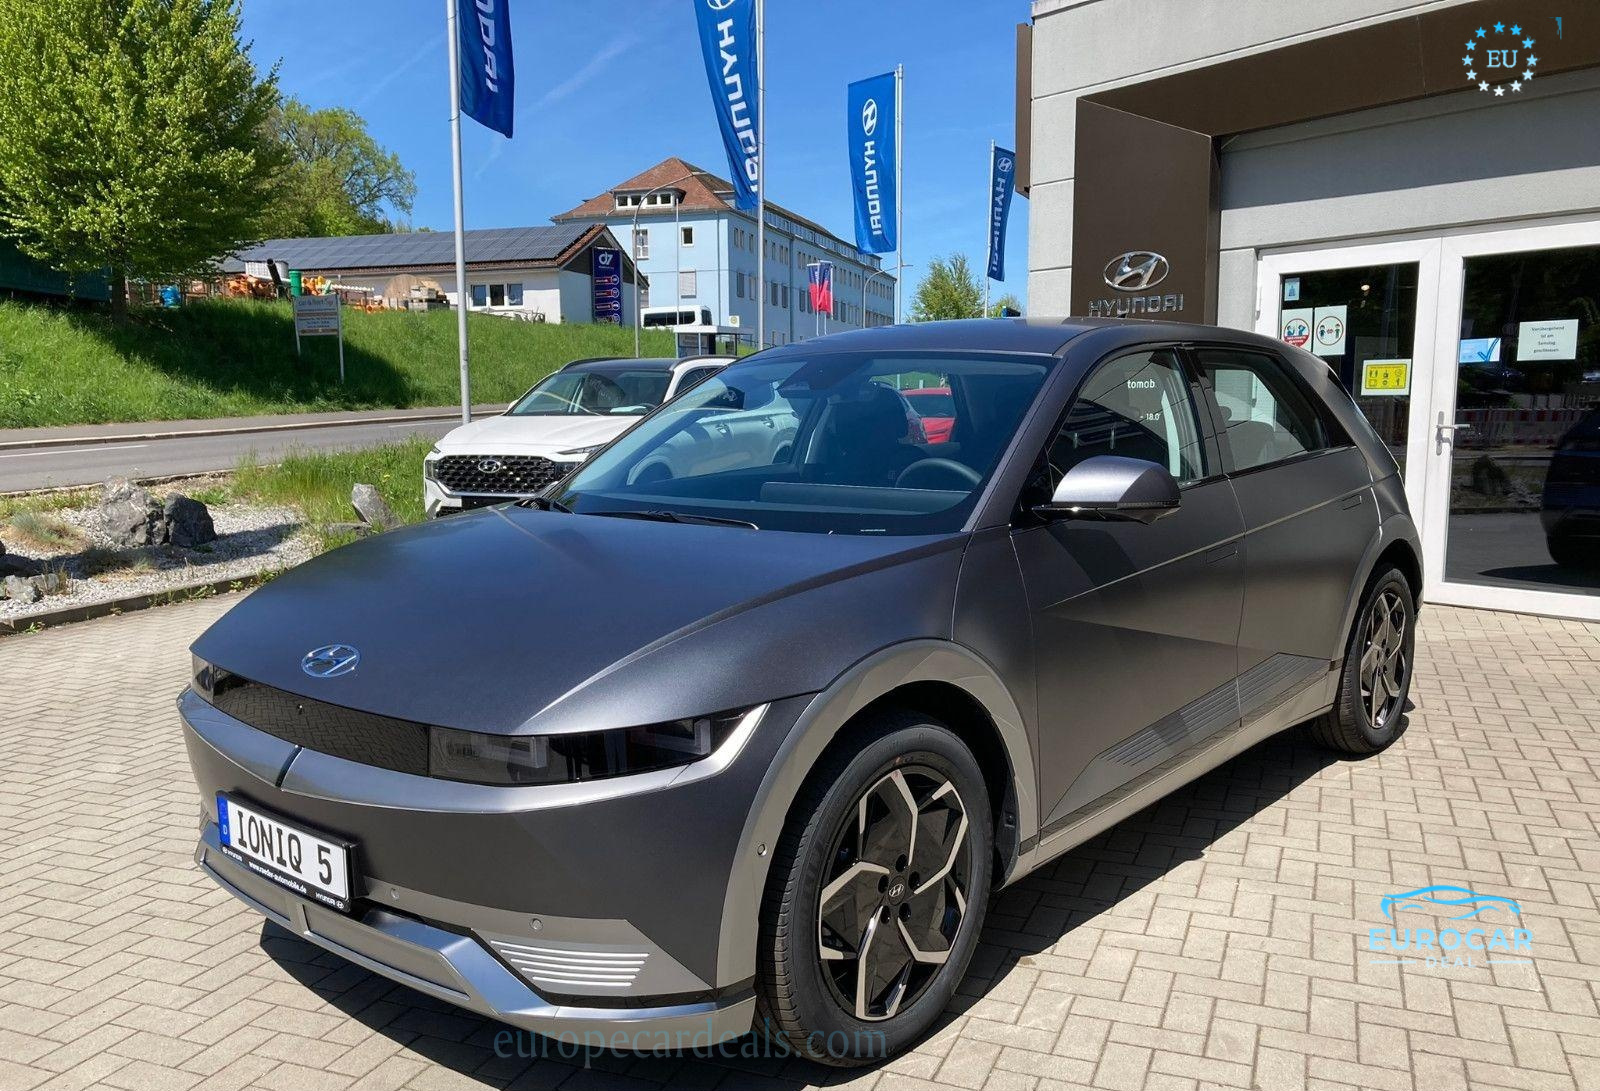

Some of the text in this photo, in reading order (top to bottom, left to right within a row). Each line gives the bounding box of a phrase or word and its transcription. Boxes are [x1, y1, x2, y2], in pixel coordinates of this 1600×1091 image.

[1088, 293, 1184, 318] HYUNDAI
[1127, 379, 1155, 389] tomob
[237, 810, 333, 885] IONIQ 5
